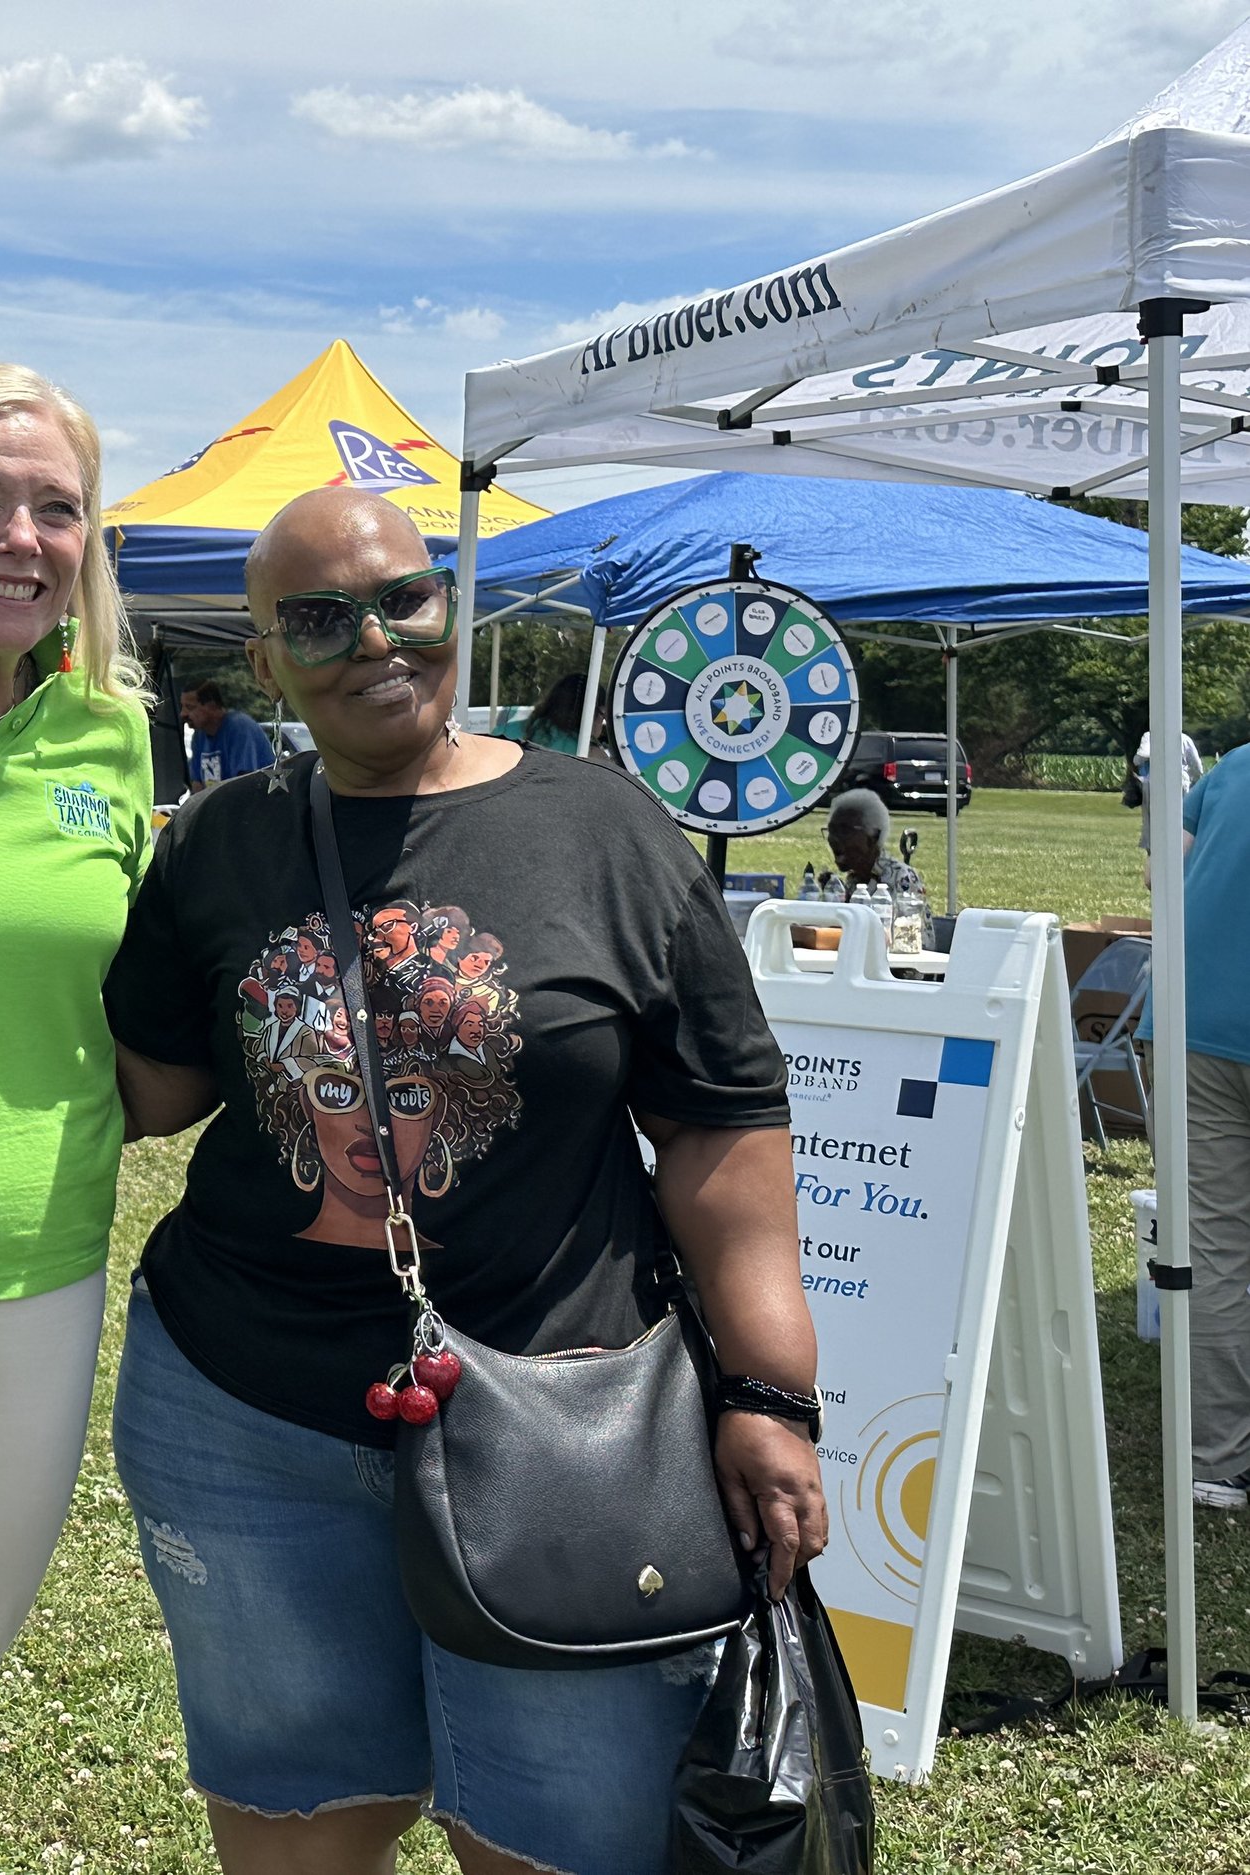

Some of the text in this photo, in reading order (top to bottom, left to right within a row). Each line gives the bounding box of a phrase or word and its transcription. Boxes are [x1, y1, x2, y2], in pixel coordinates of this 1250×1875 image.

[695, 663, 782, 722] ALL POINTS BROADBAND
[693, 713, 709, 736] LIVE
[784, 1053, 862, 1077] POINTS
[319, 1081, 352, 1107] my
[790, 1073, 858, 1091] DBAND
[390, 1083, 430, 1109] roots
[791, 1131, 912, 1168] nternet
[795, 1172, 928, 1219] For You.
[817, 1242, 861, 1262] our
[800, 1272, 869, 1299] ernet
[816, 1446, 858, 1465] evice
